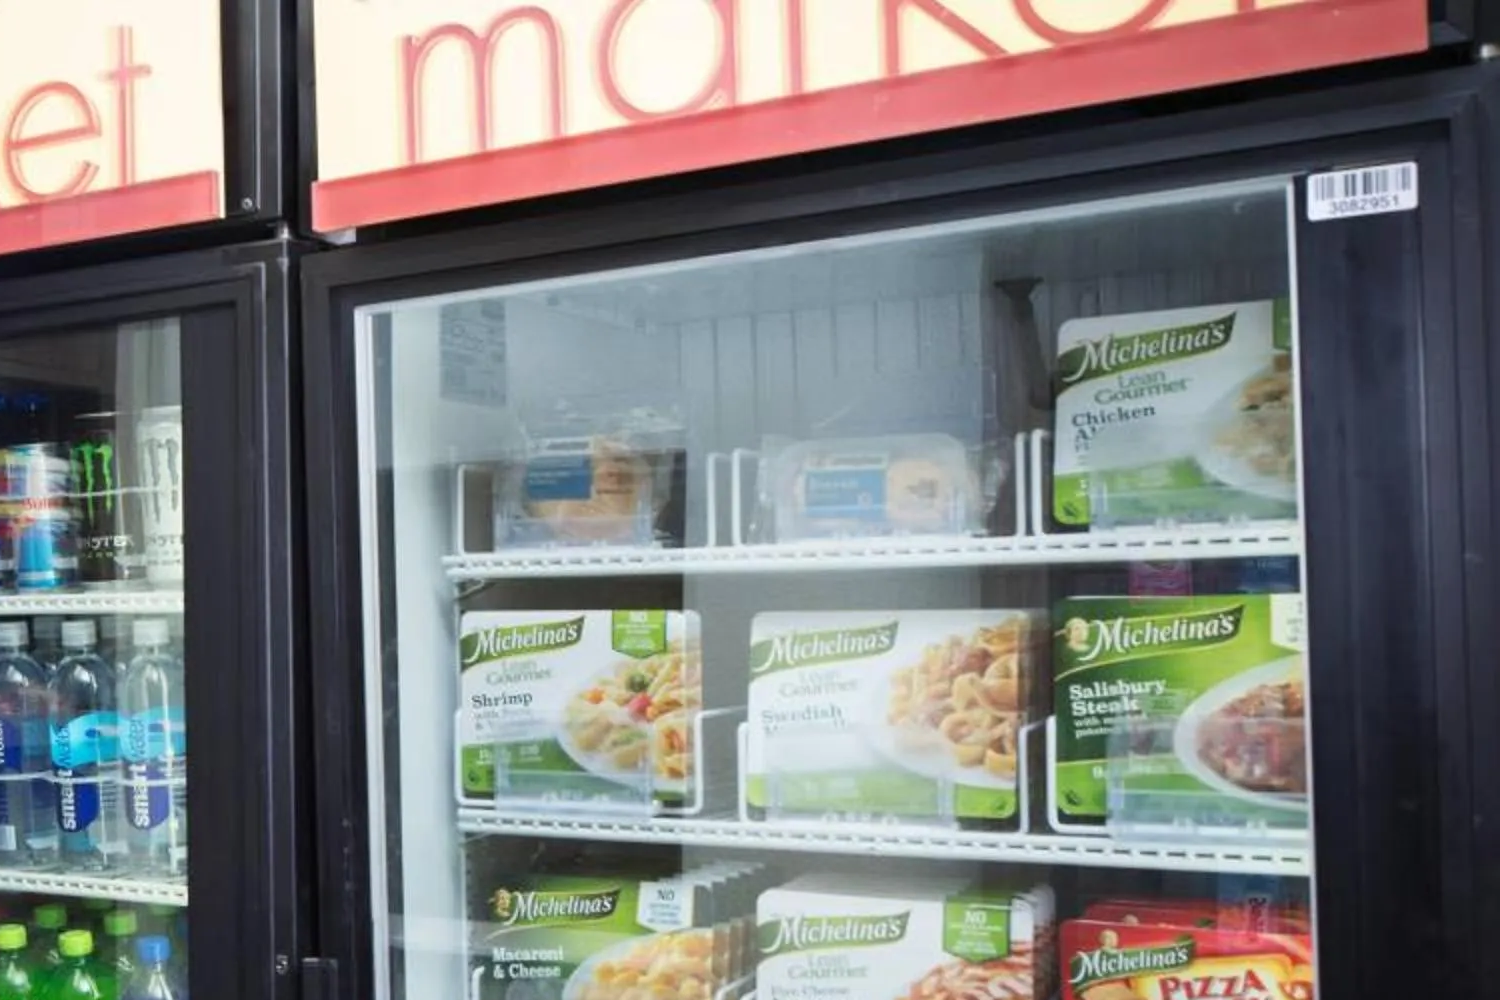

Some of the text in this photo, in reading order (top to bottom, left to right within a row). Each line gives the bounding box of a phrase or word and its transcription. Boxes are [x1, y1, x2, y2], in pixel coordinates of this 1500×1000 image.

[1062, 322, 1227, 382] Michelina's
[1094, 377, 1189, 405] Gourmet
[1116, 370, 1167, 388] Lean
[1071, 406, 1156, 428] Chicken
[463, 622, 579, 664] Michelina's
[752, 628, 891, 673] Michelina's
[1077, 614, 1235, 661] Michelina's
[471, 691, 534, 708] Shrimp
[1069, 679, 1167, 701] Salisbury
[761, 703, 843, 725] Swedish
[1072, 698, 1140, 716] Steak
[58, 768, 77, 830] smart
[130, 763, 150, 828] smart
[503, 890, 613, 926] Michelina's
[964, 911, 987, 924] NO
[760, 913, 902, 954] Michelina's
[492, 946, 564, 962] Macaroni
[1069, 946, 1190, 984] Michelina's
[493, 963, 561, 979] & Cheese
